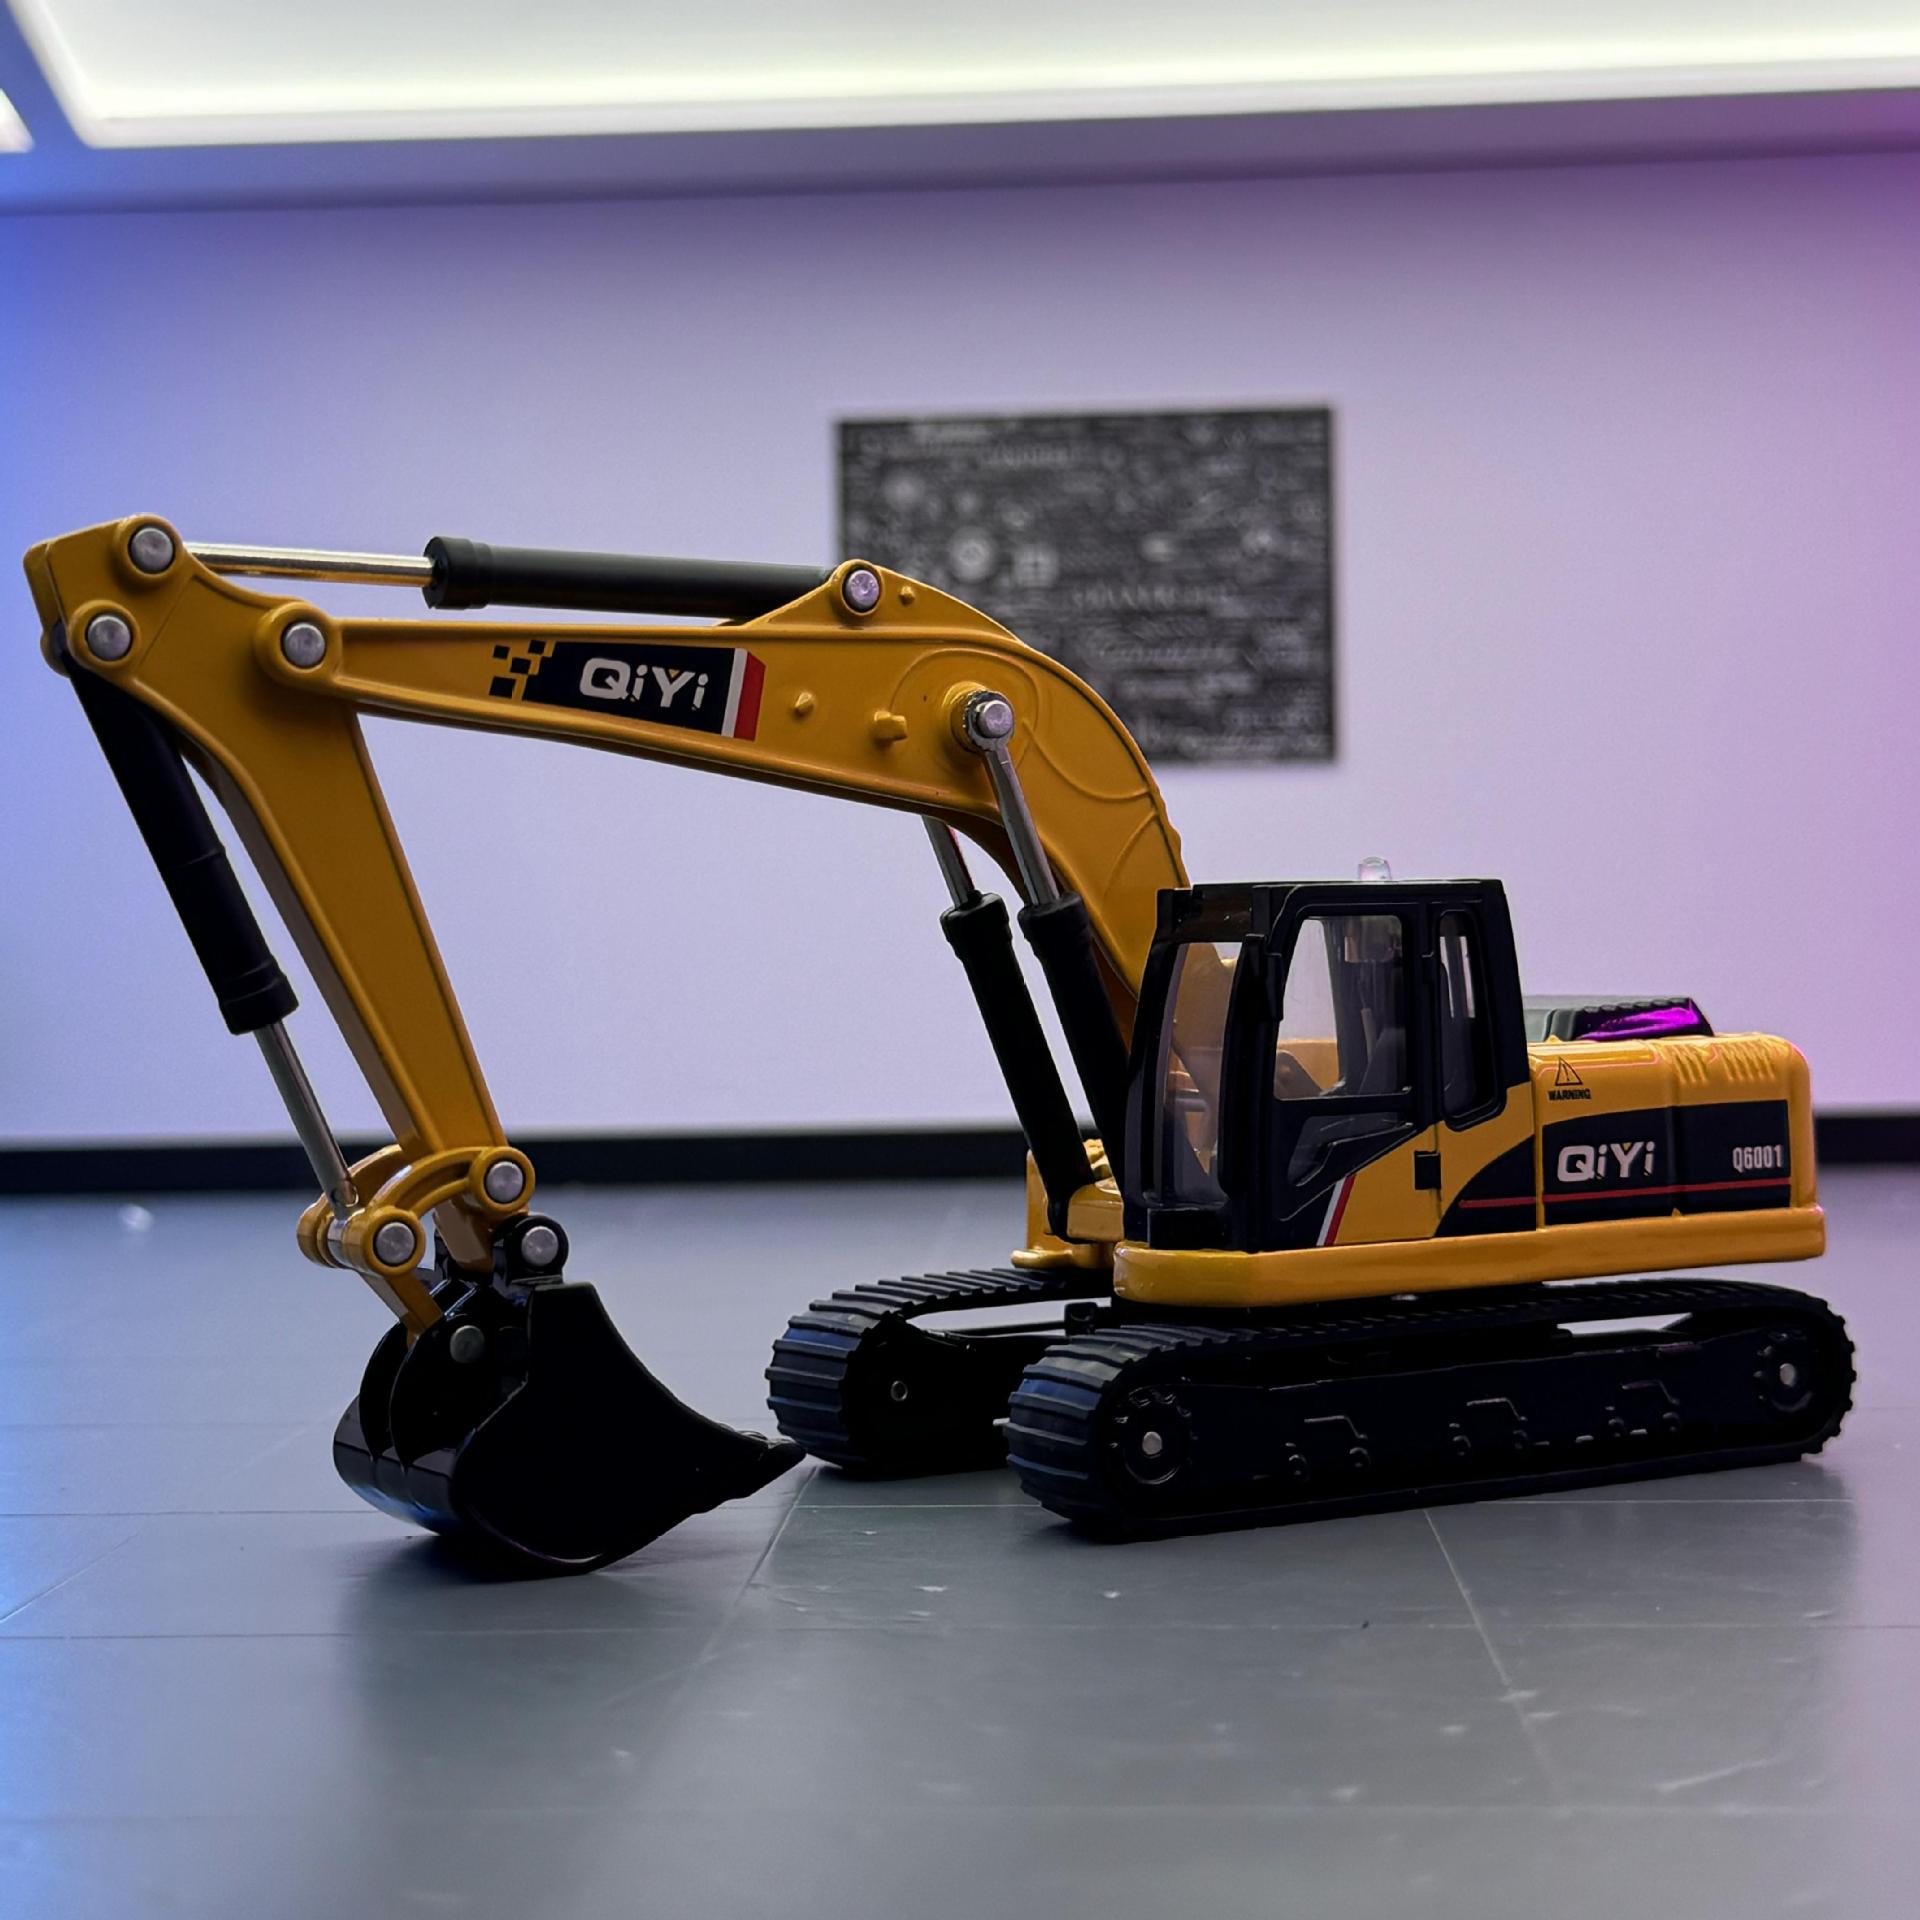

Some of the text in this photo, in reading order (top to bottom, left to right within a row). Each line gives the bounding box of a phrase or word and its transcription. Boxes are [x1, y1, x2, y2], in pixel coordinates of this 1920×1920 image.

[579, 657, 708, 711] QiYi
[1548, 1089, 1591, 1100] WARNING
[1557, 1141, 1655, 1182] QiYi
[1732, 1145, 1783, 1173] Q6001
